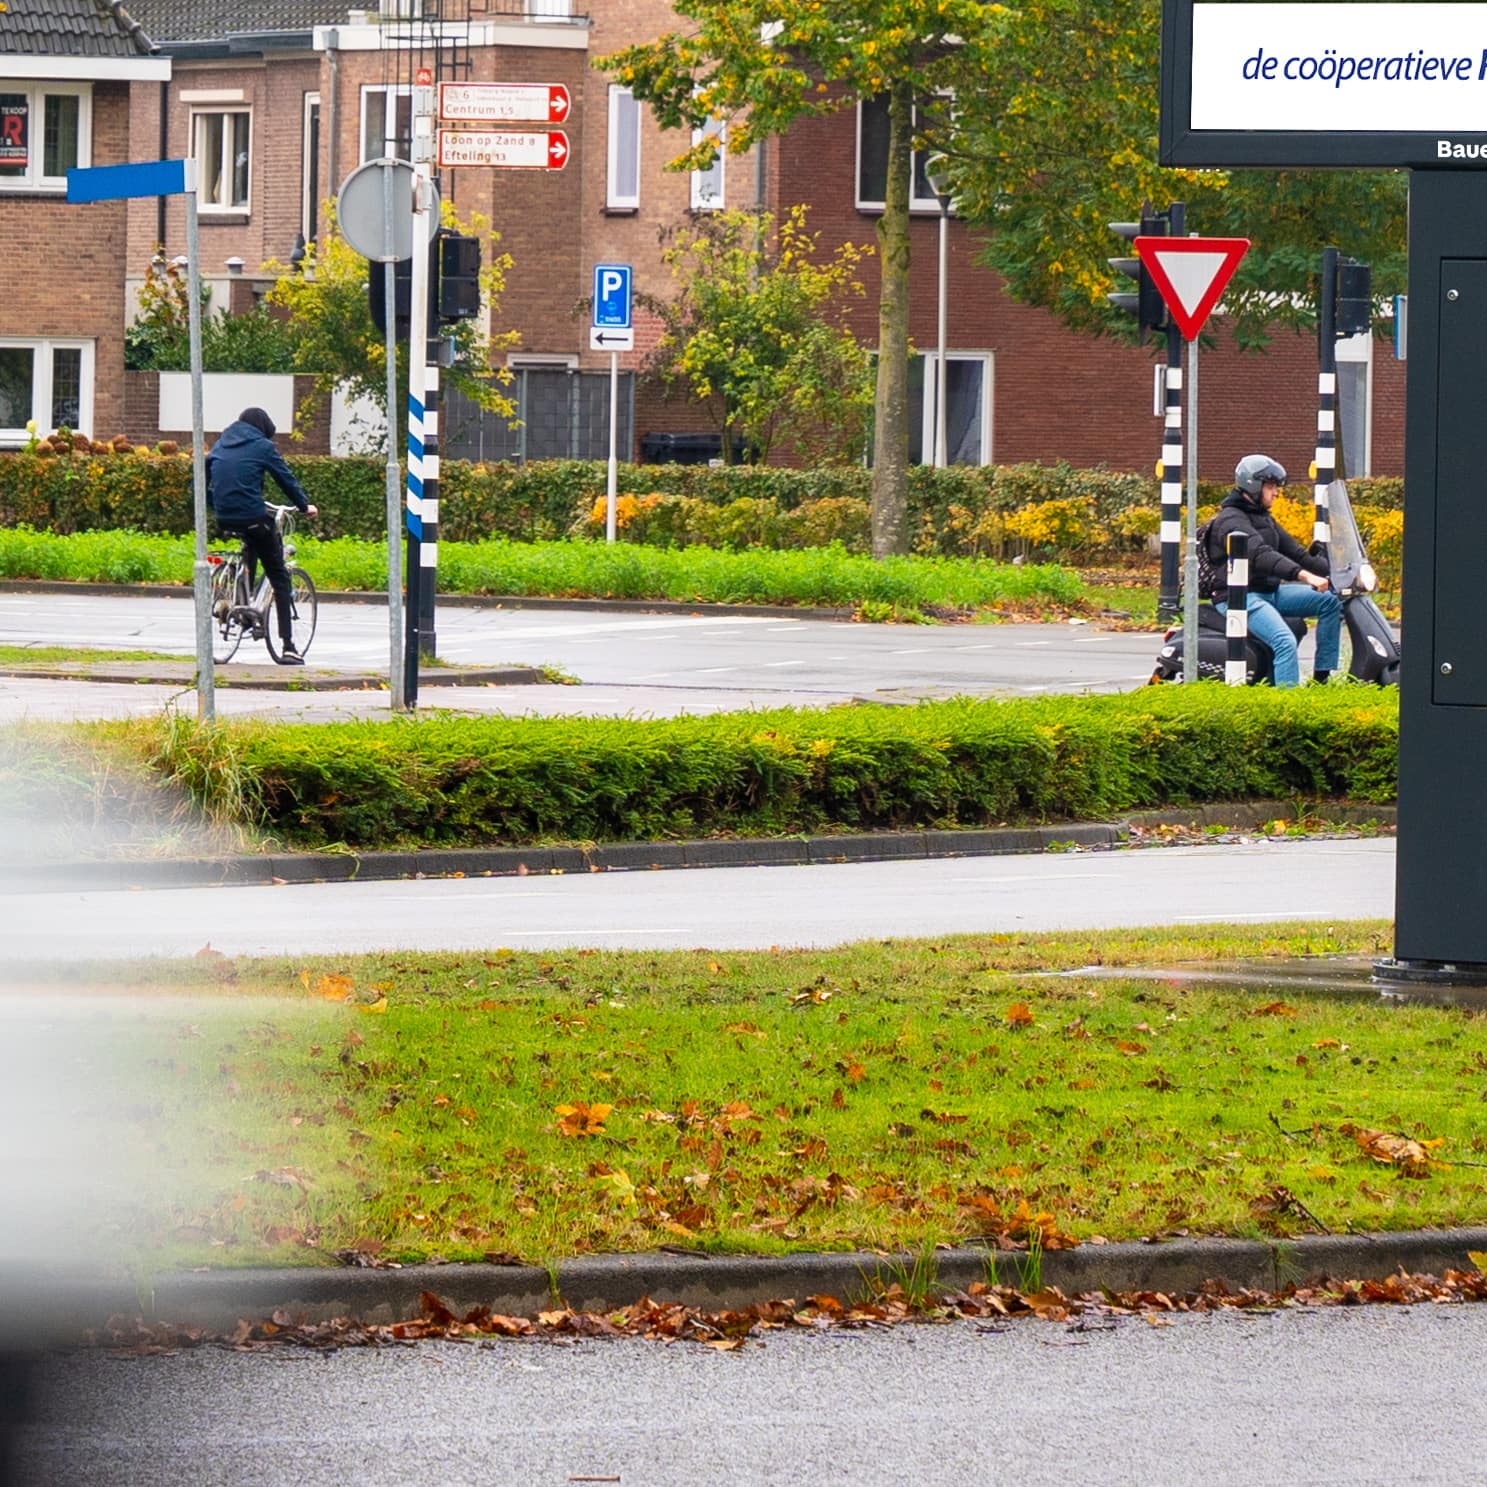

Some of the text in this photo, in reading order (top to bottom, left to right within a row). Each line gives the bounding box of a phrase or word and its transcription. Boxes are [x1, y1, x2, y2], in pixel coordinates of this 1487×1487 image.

[1242, 47, 1277, 80] de
[1283, 47, 1472, 89] coöperatieve
[445, 105, 496, 114] Centrum
[445, 136, 473, 146] Loon
[477, 138, 492, 147] op
[496, 136, 524, 146] Zand
[445, 150, 491, 163] Efteling
[602, 271, 623, 302] P
